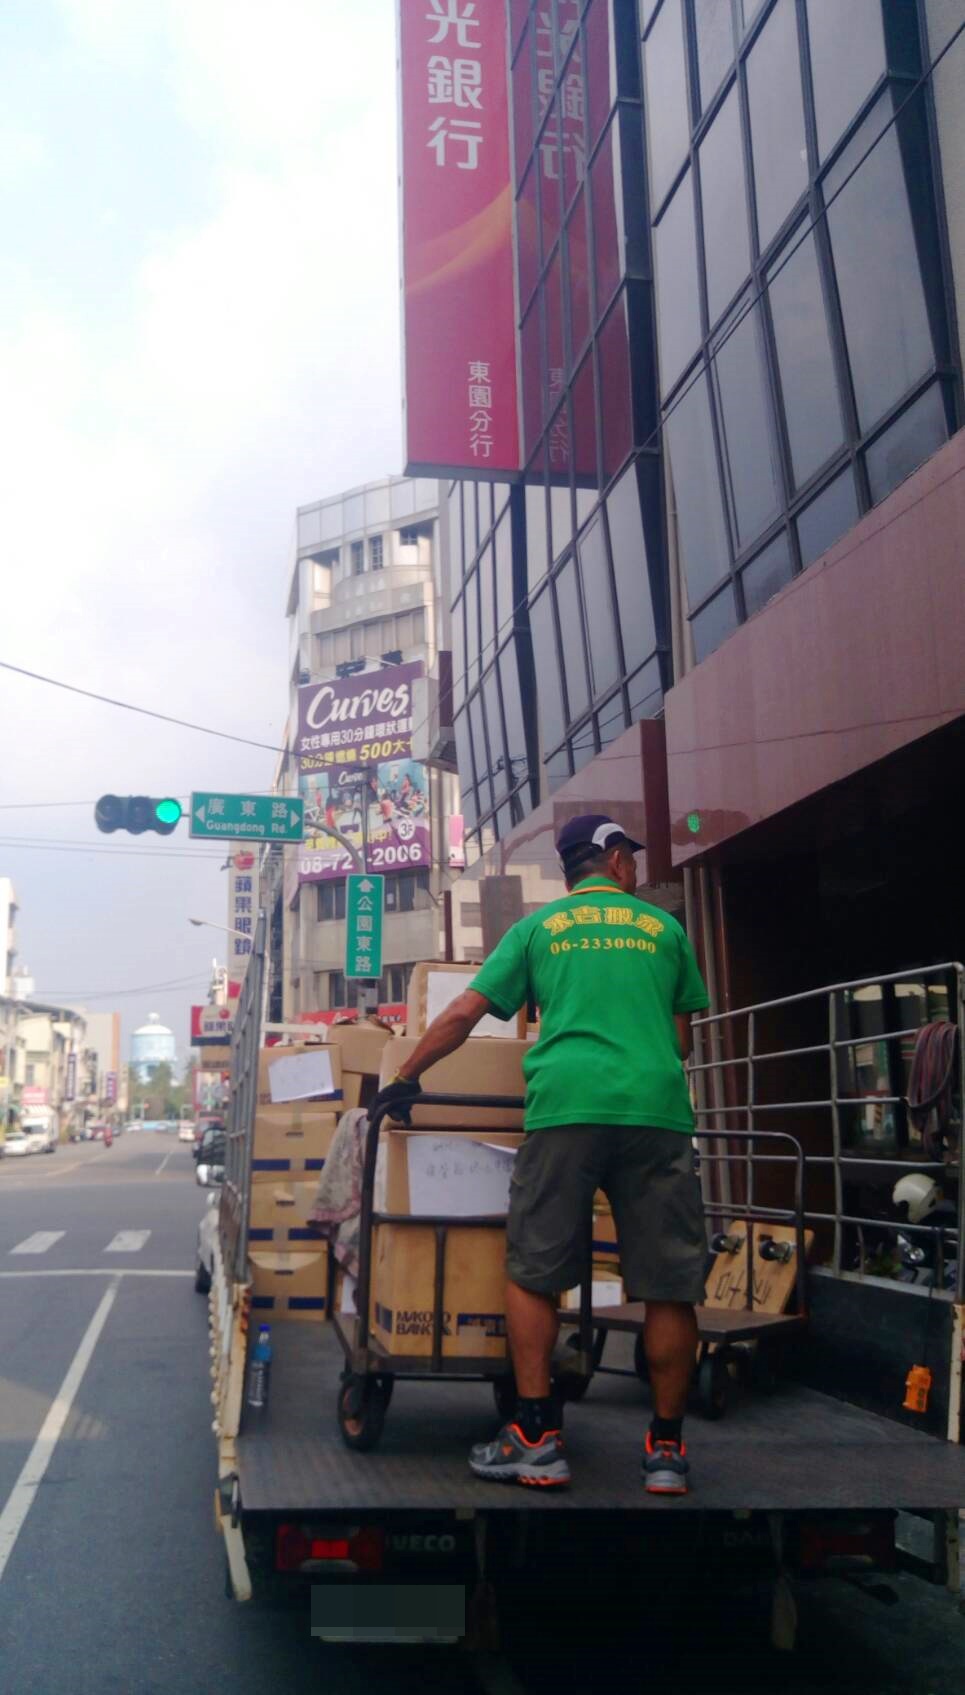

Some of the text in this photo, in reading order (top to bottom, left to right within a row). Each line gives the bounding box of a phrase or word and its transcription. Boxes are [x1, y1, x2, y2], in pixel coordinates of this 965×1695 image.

[425, 0, 483, 170] 光銀行
[467, 360, 494, 458] 東園分行
[306, 684, 409, 729] Curves
[206, 820, 265, 834] Guangdong
[208, 798, 288, 818] 廣東路
[301, 843, 421, 874] 08-72-2006
[235, 876, 252, 955] 蘋果眼鏡
[354, 896, 374, 972] 公園東路
[551, 937, 657, 954] 06-2330000
[397, 1311, 451, 1322] MAKOO
